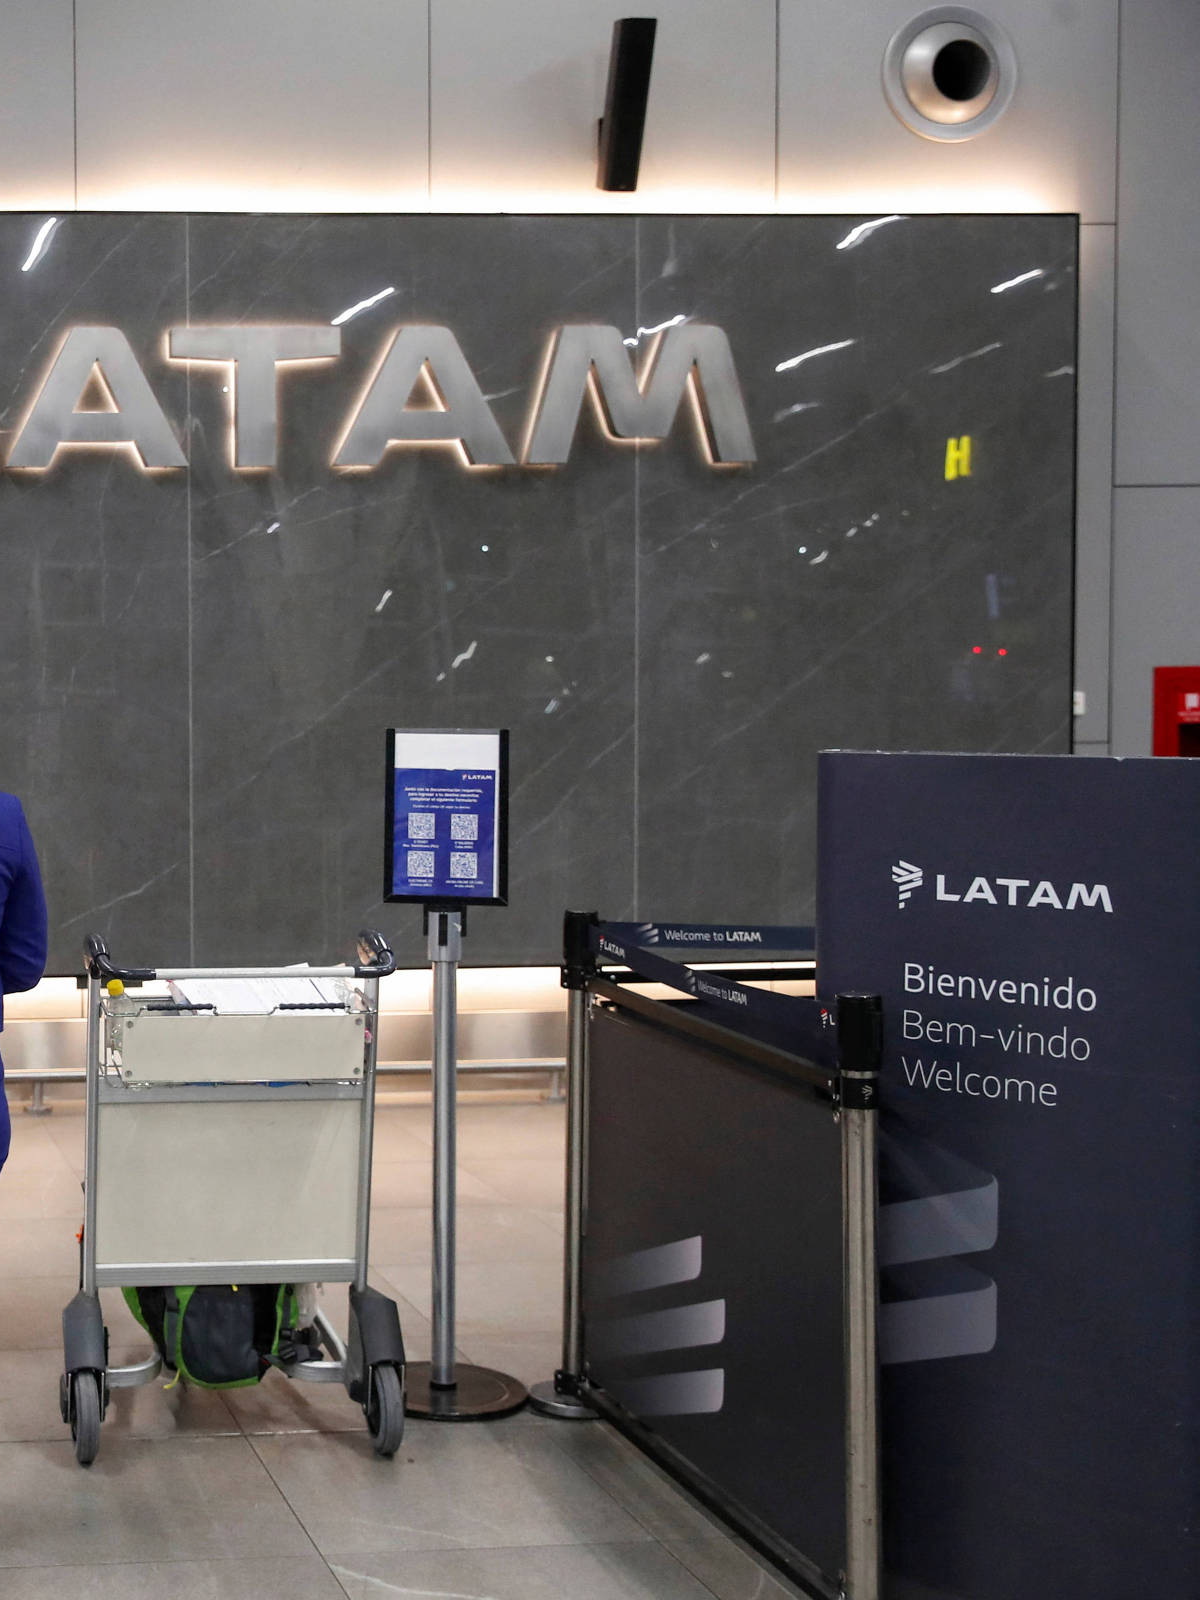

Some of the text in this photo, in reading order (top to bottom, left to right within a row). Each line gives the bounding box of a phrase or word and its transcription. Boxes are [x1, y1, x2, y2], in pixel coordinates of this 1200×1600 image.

[936, 874, 1114, 913] LATAM
[603, 942, 626, 959] LATAM
[664, 929, 762, 943] Welcome to LATAM
[697, 980, 748, 1006] Welcome to LATAM
[904, 962, 1098, 1012] Bienvenido
[903, 1009, 1091, 1061] Bem-vindo
[901, 1055, 1058, 1107] Welcome
